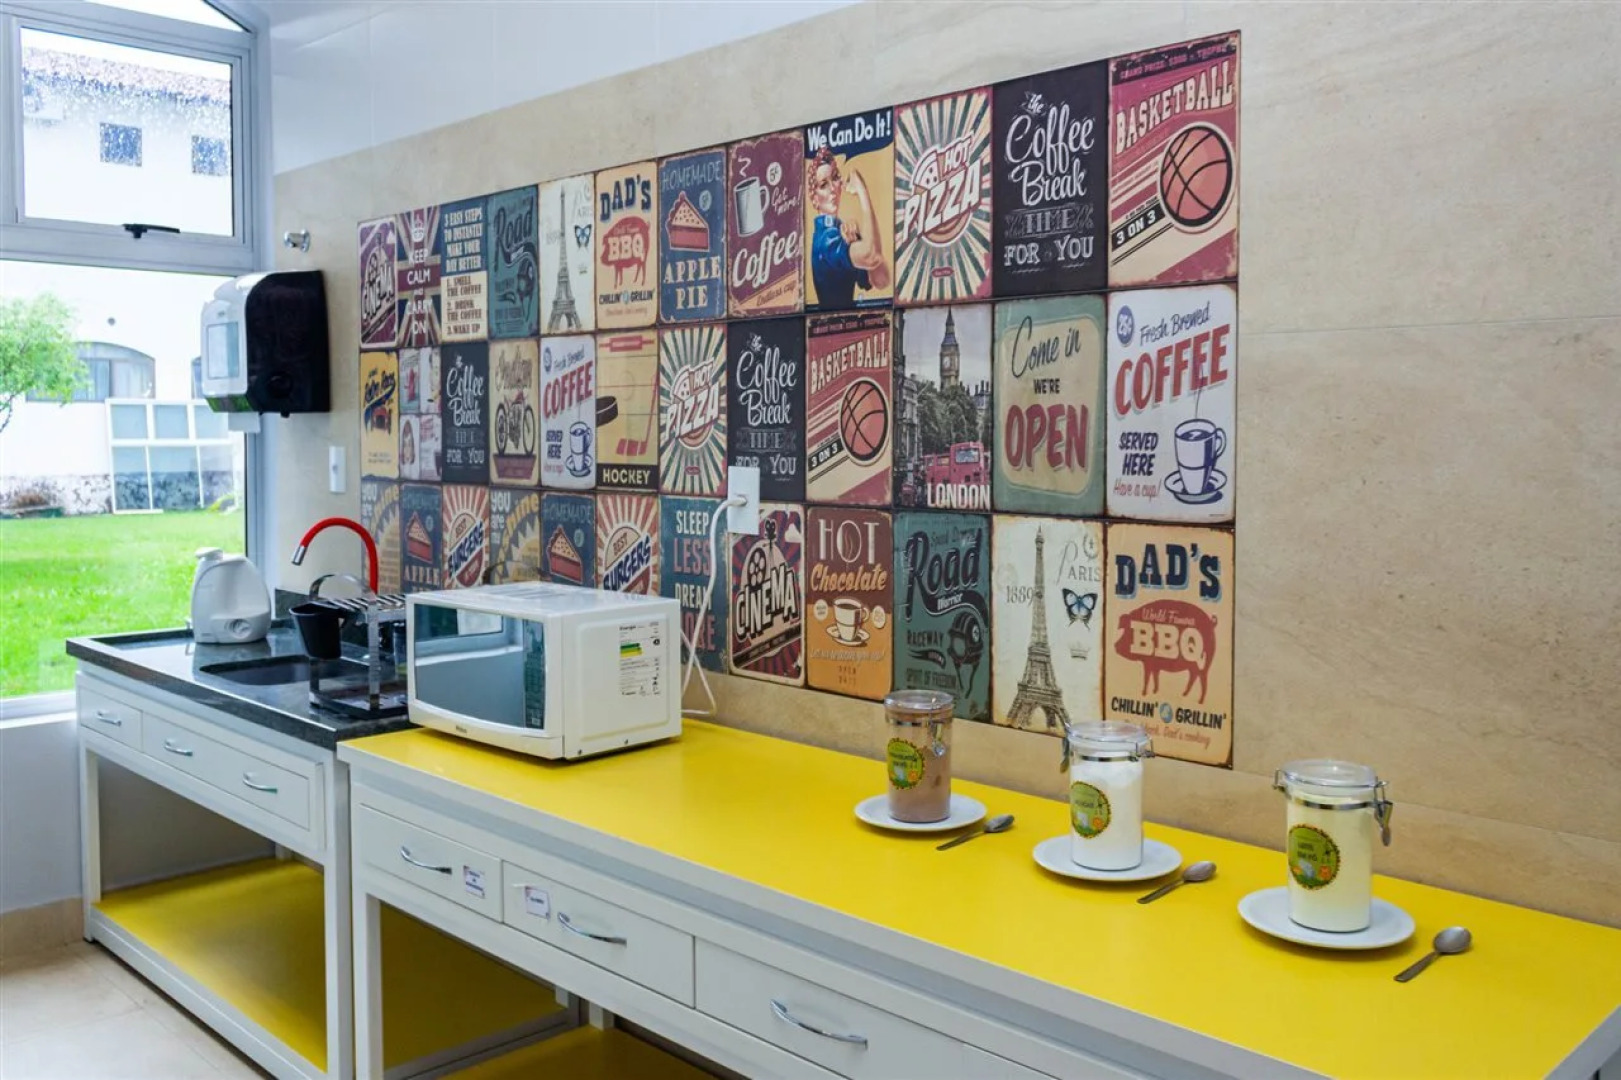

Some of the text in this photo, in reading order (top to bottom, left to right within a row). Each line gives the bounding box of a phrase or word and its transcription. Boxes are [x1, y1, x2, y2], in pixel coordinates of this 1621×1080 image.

[1115, 60, 1233, 154] BASKETBALL
[807, 110, 891, 152] We Can Do It!
[1005, 103, 1095, 176] Coffee
[662, 161, 722, 190] HOMEMADE
[943, 140, 973, 177] HOT
[600, 174, 652, 222] DAD'S
[903, 158, 980, 241] PIZZA
[1007, 158, 1087, 206] Break
[1025, 208, 1074, 234] TIME
[1116, 209, 1156, 245] 3 ON 3
[408, 248, 428, 266] KEEP
[607, 232, 646, 263] BBQ
[732, 231, 799, 290] Coffee
[1003, 233, 1094, 266] FOR YOU
[407, 268, 431, 285] CALM
[663, 255, 721, 284] APPLE
[675, 285, 708, 310] PIE
[412, 320, 427, 335] ON
[1140, 300, 1210, 346] Fresh Brewed
[810, 332, 889, 395] BASKETBALL
[1011, 315, 1081, 378] Come in
[446, 364, 484, 409] Coffee
[543, 360, 593, 418] COFFEE
[736, 347, 797, 404] Coffee
[1033, 378, 1061, 394] WE'RE
[1114, 323, 1231, 418] COFFEE
[447, 397, 481, 426] Break
[665, 382, 719, 440] PIZZA
[739, 389, 792, 427] Break
[811, 442, 838, 467] 3 ON 3
[1004, 403, 1089, 470] OPEN
[1118, 432, 1159, 451] SERVED
[467, 447, 485, 464] YOU
[769, 453, 797, 475] YOU
[1121, 453, 1156, 476] HERE
[602, 468, 651, 485] HOCKEY
[1113, 478, 1133, 497] Have
[926, 482, 991, 510] LONDON
[676, 509, 709, 536] SLEEP
[673, 537, 712, 577] LESS
[818, 518, 880, 565] HOT
[810, 562, 888, 593] Chocolate
[905, 527, 982, 621] Road
[1114, 543, 1221, 602] DAD'S
[735, 563, 801, 640] CINEMA
[681, 610, 715, 651] ORE
[1129, 620, 1207, 671] BBQ
[1111, 696, 1158, 718] CHILLIN'
[1175, 708, 1227, 730] GRILLIN'
